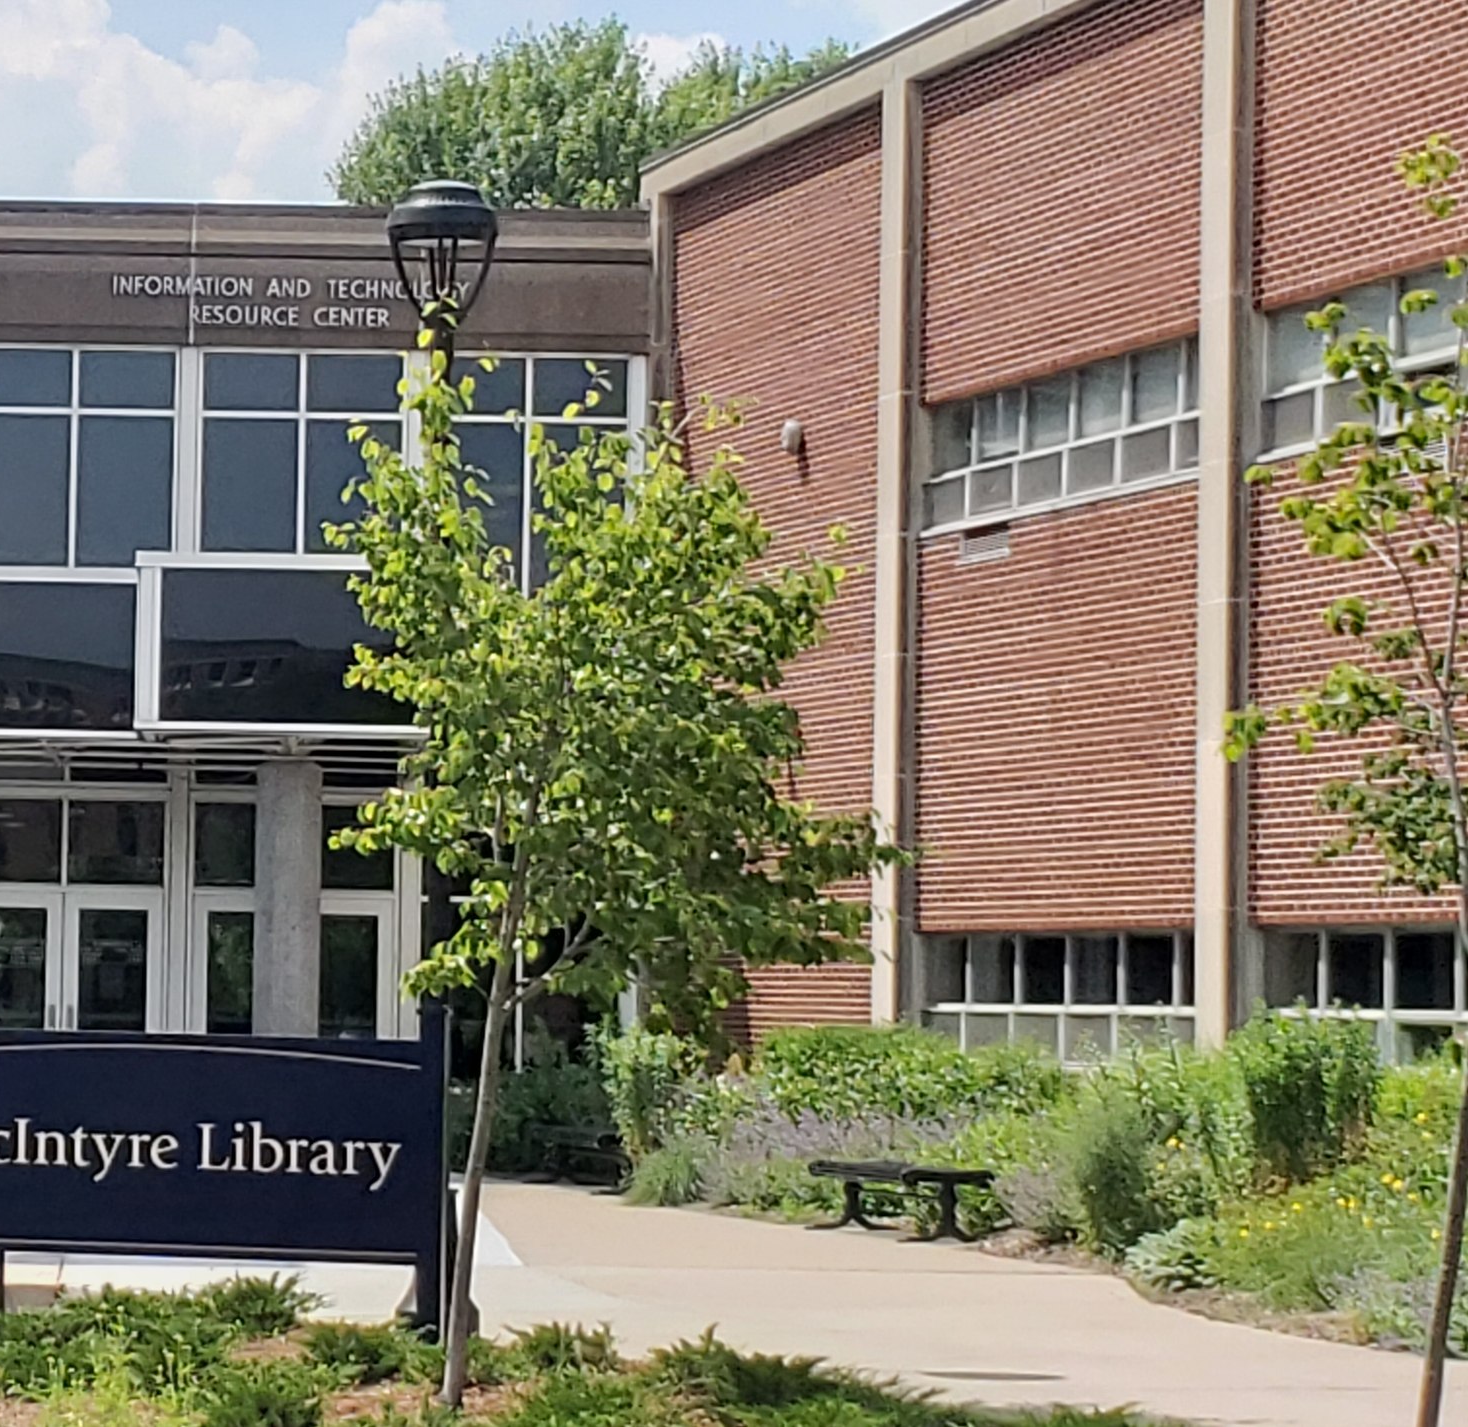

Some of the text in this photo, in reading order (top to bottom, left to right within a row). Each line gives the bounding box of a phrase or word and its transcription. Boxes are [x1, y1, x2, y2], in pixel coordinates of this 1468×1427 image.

[112, 275, 470, 301] INFORMATION AND TECHNOLOY
[191, 305, 390, 328] RESOURCE CENTER
[196, 1121, 402, 1191] Library
